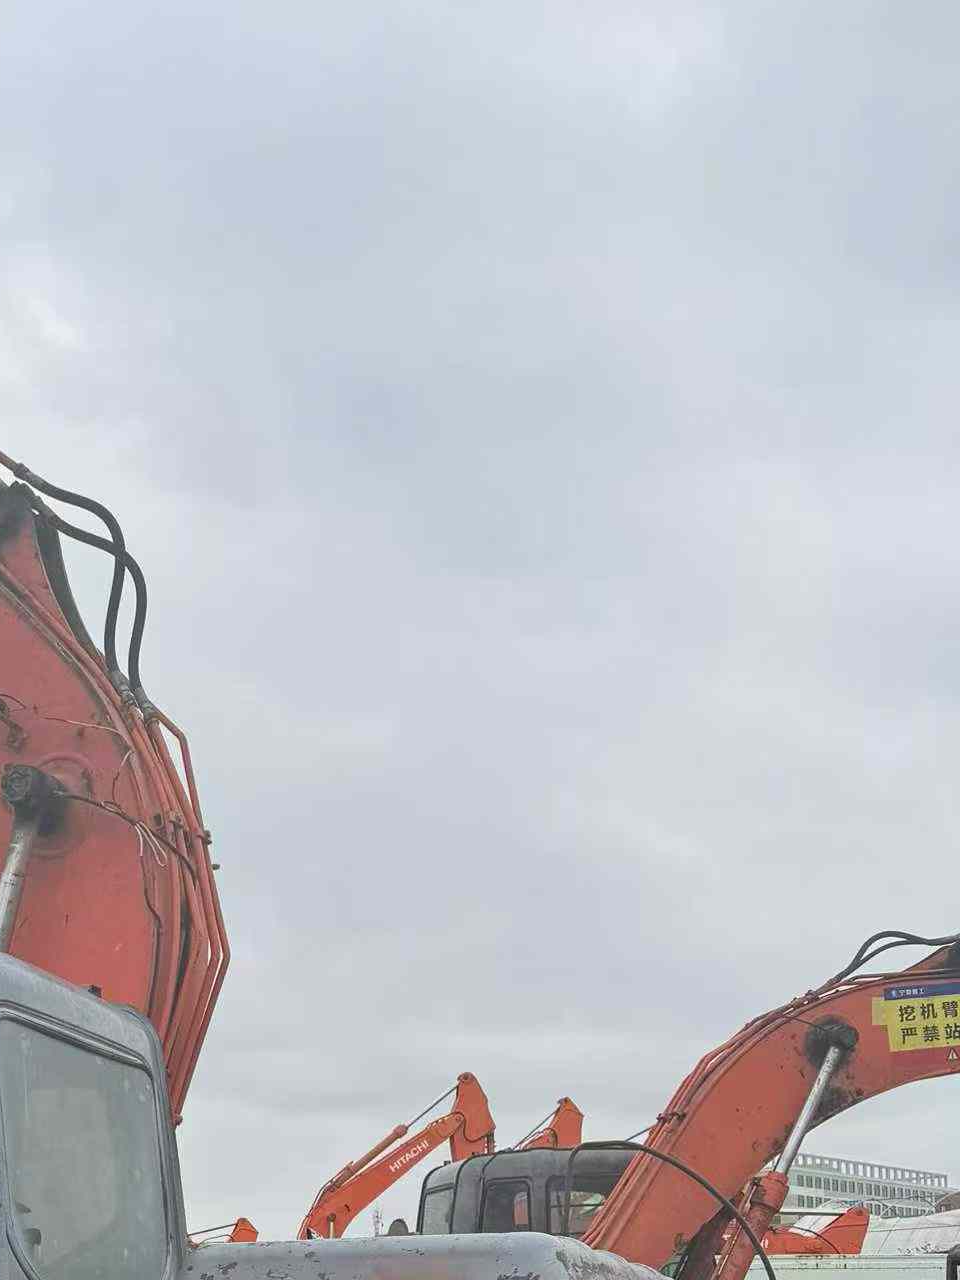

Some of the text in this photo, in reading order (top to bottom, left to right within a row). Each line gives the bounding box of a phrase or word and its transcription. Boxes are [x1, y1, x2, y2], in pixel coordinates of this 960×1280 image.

[898, 1001, 958, 1022] 挖机臂
[389, 1140, 429, 1172] HITACHI
